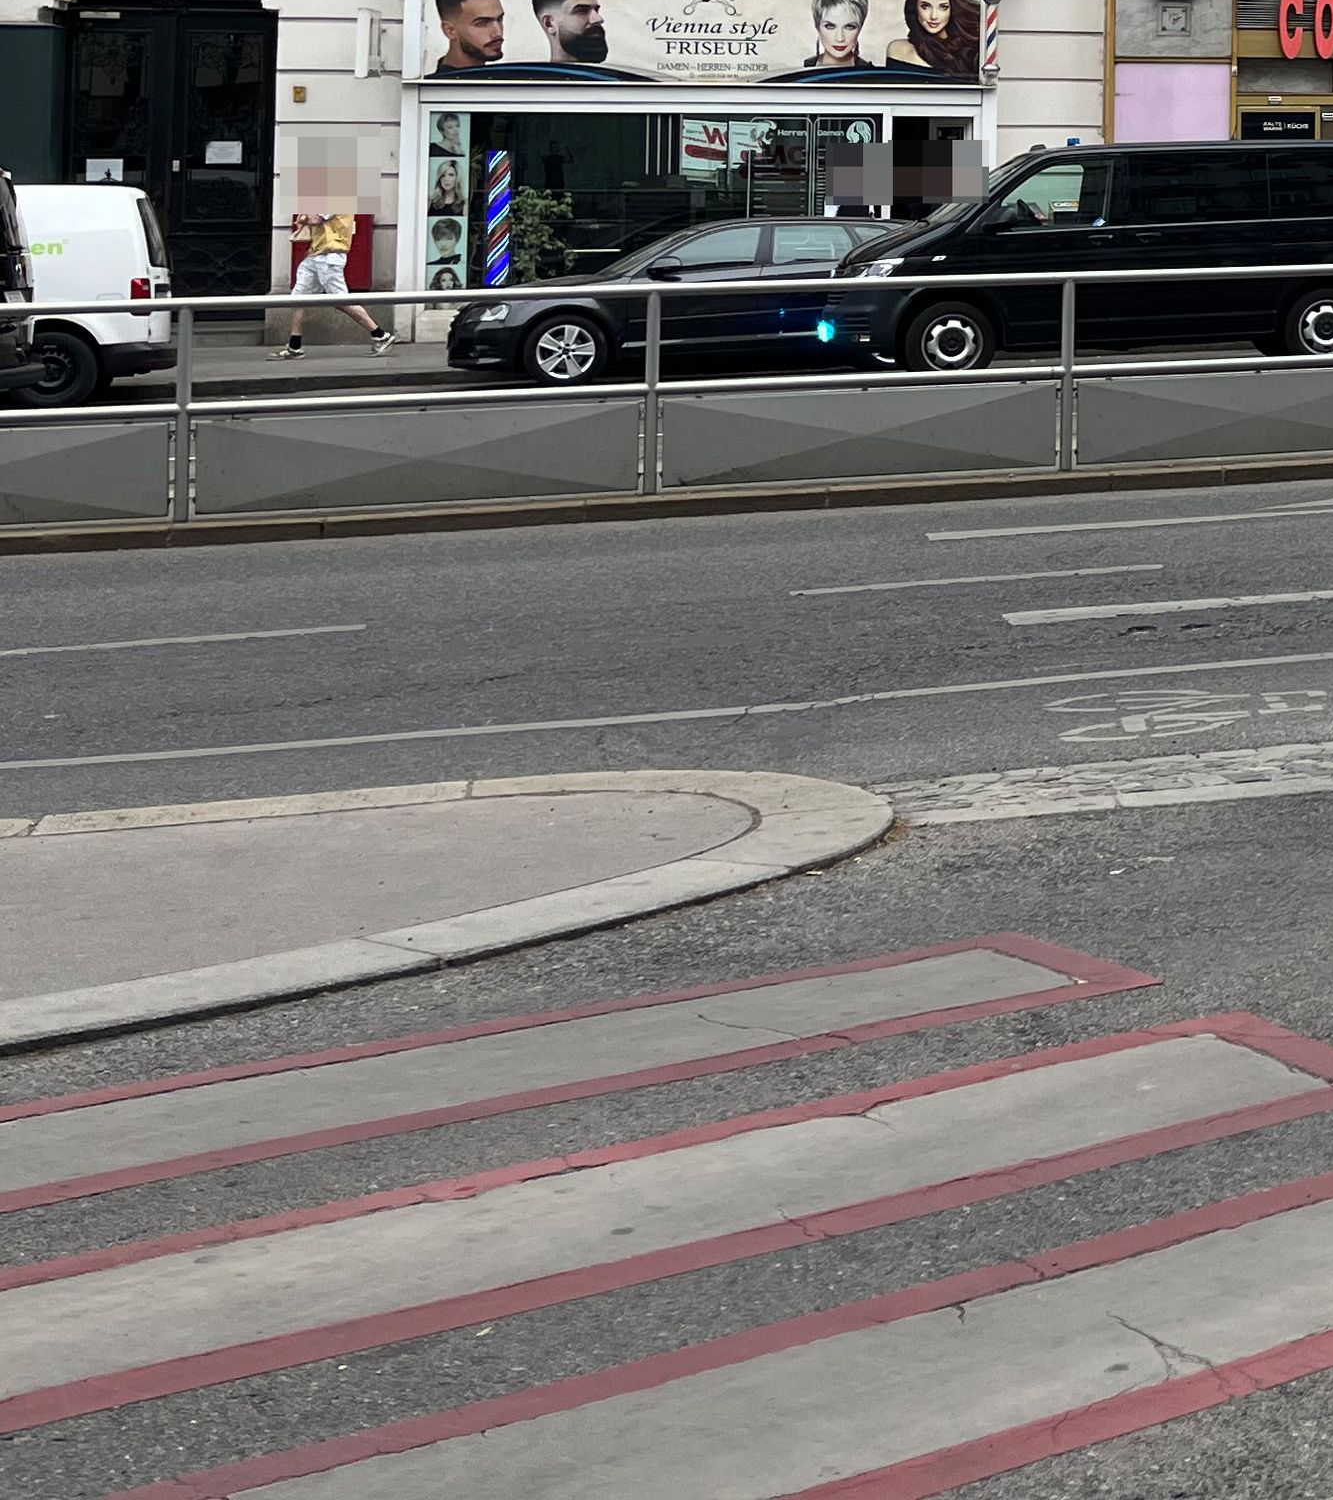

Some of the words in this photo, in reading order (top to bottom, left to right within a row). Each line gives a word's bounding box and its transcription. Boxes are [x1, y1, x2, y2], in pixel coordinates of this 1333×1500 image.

[646, 16, 723, 34] Vienna
[729, 17, 779, 41] style
[665, 41, 759, 55] FRISEUR
[656, 62, 690, 71] DAMEN
[697, 63, 731, 71] HERREN
